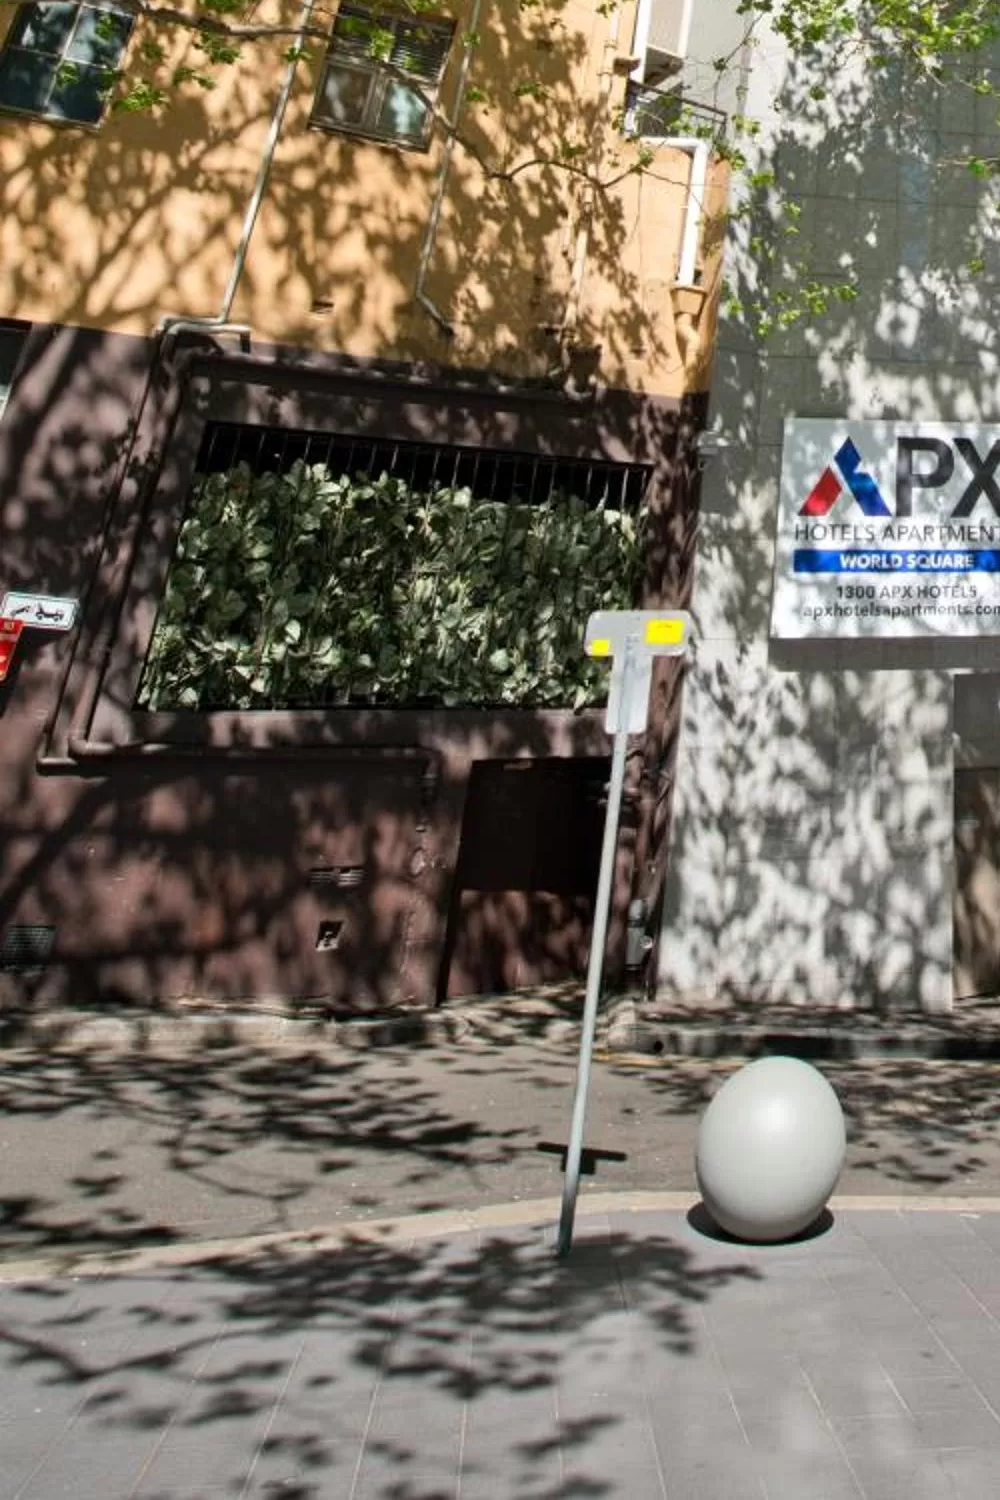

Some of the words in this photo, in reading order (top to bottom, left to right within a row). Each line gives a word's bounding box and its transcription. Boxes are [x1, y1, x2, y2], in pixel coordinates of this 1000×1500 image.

[795, 524, 875, 541] HOTELS
[840, 553, 902, 568] WORLD
[907, 553, 974, 569] SQUARE
[836, 585, 875, 598] 1300
[879, 585, 912, 598] APX
[917, 585, 977, 598] HOTELS
